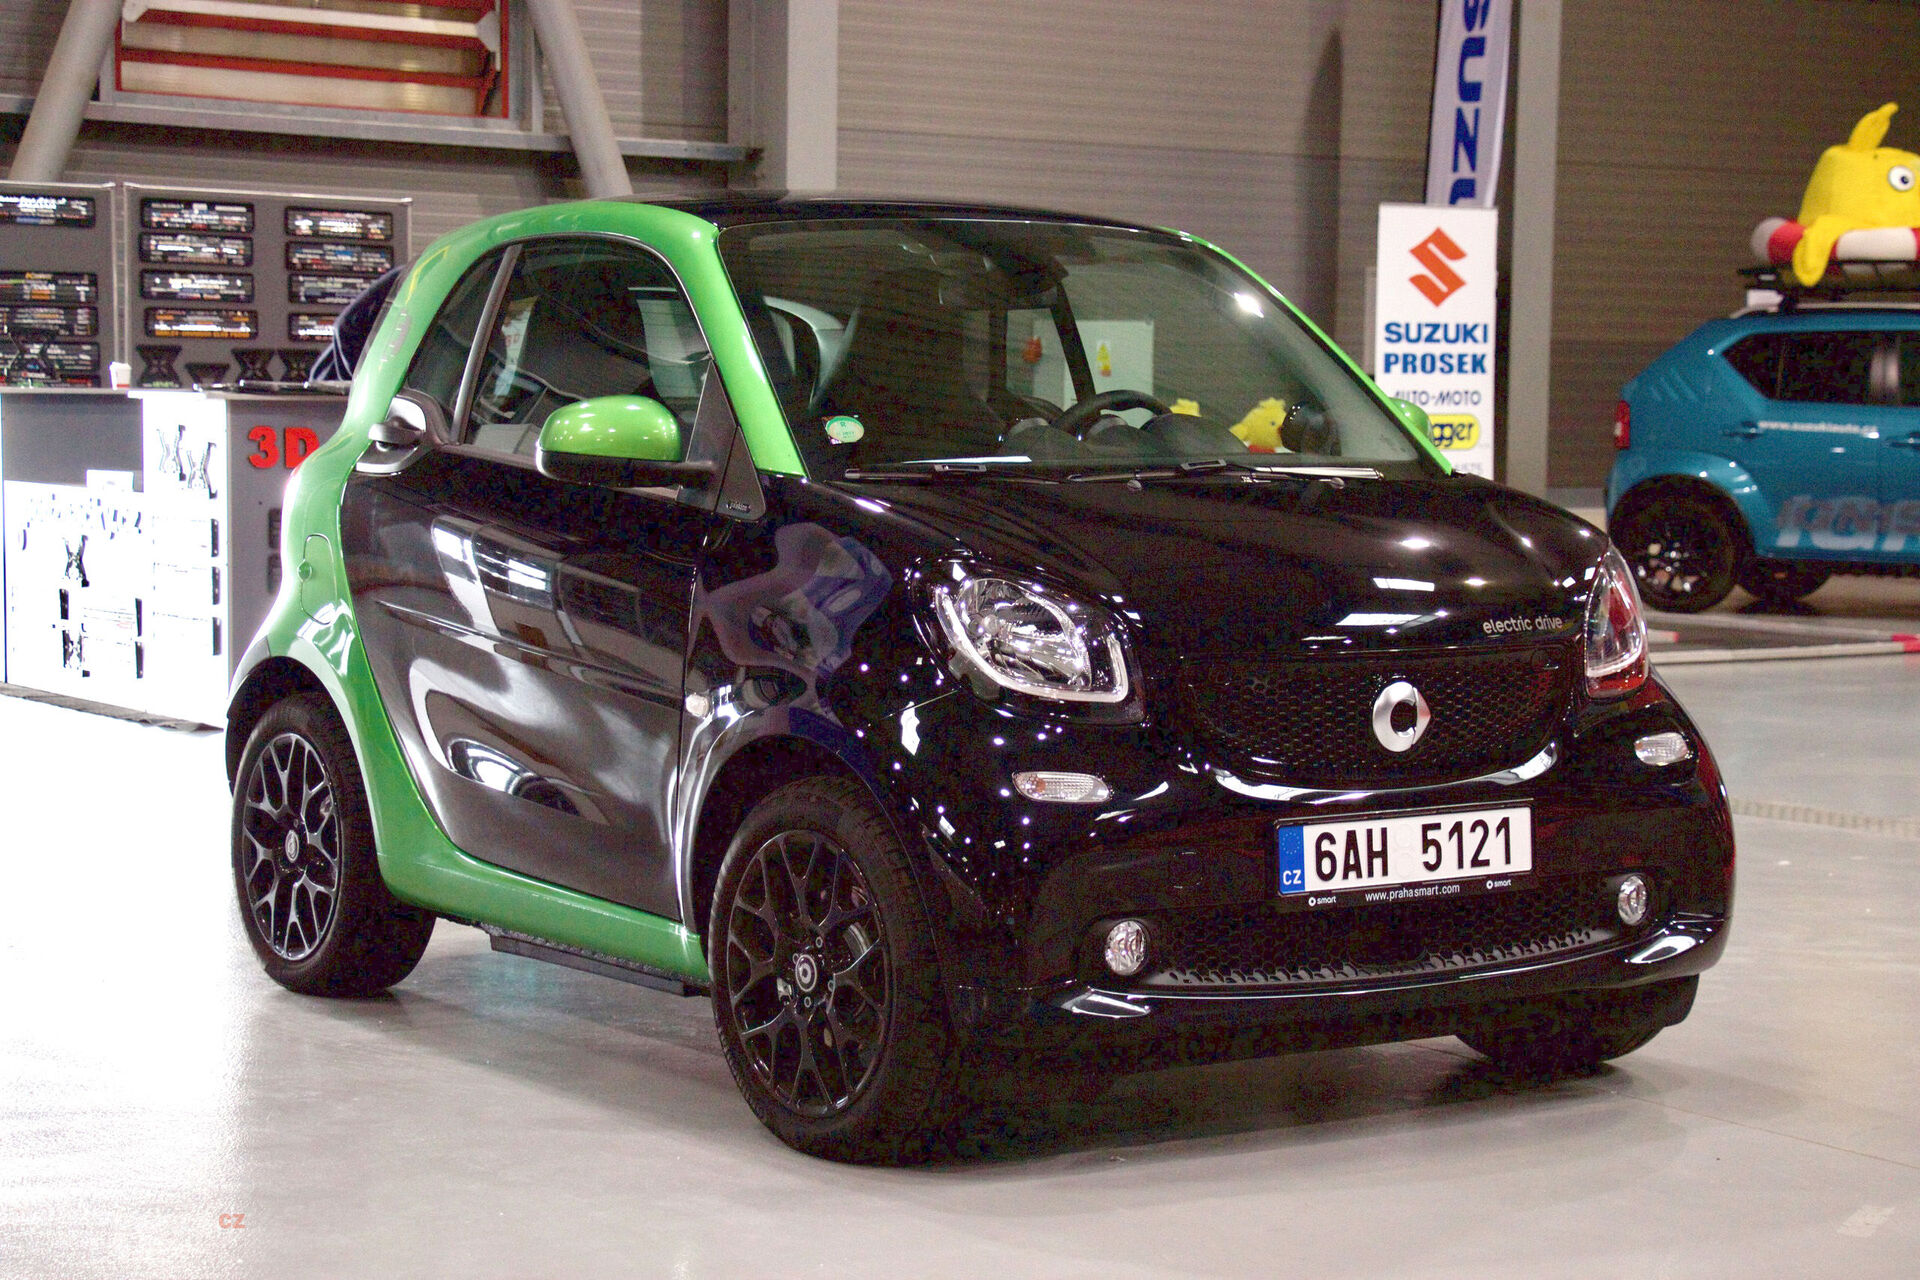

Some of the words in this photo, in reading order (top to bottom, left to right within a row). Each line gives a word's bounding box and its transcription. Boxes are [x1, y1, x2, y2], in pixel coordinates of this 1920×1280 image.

[1384, 322, 1488, 344] SUZUKI
[1383, 352, 1486, 375] PROSEK
[1482, 616, 1532, 634] electric
[1535, 614, 1563, 630] drive
[1315, 827, 1388, 882] 6AH
[1421, 816, 1511, 872] 5121
[1282, 869, 1302, 886] CZ
[1365, 883, 1460, 902] www.prahasmart.com
